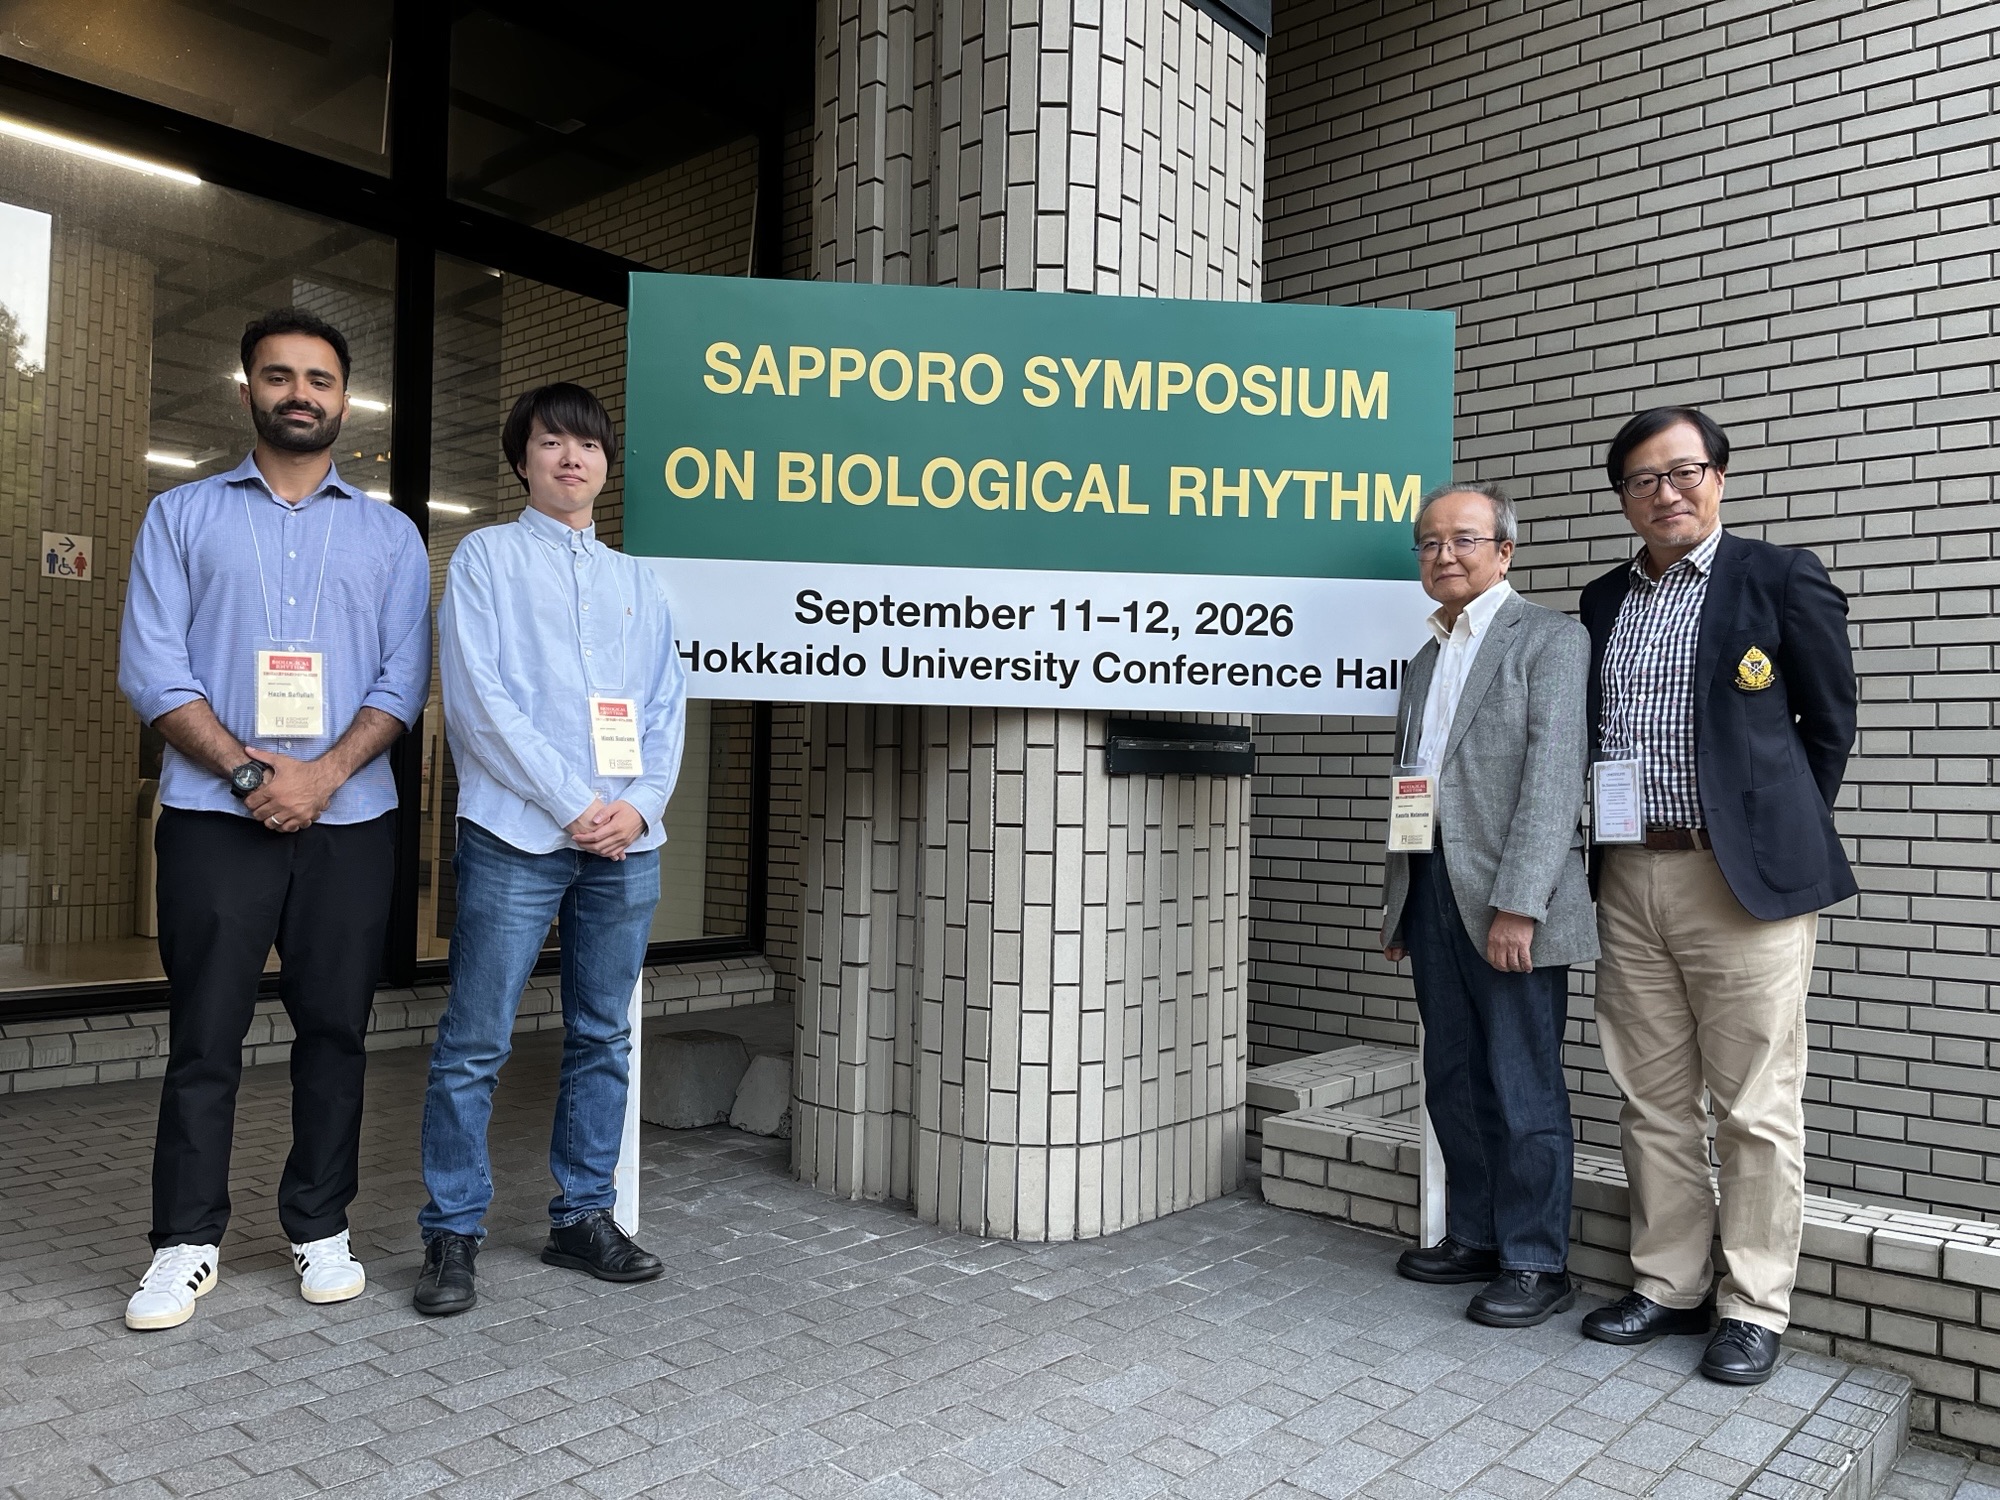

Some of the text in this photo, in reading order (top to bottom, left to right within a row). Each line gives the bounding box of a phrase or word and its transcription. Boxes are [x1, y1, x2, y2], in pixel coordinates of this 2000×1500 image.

[703, 341, 1389, 420] SAPPORO SYMPOSIUM
[664, 446, 1422, 524] ON BIOLOGICAL RHYTHM
[794, 589, 1035, 634] September
[1195, 601, 1294, 638] 2026
[674, 639, 867, 677] Hokkaido
[882, 646, 1080, 689] University
[1092, 651, 1322, 688] Conference
